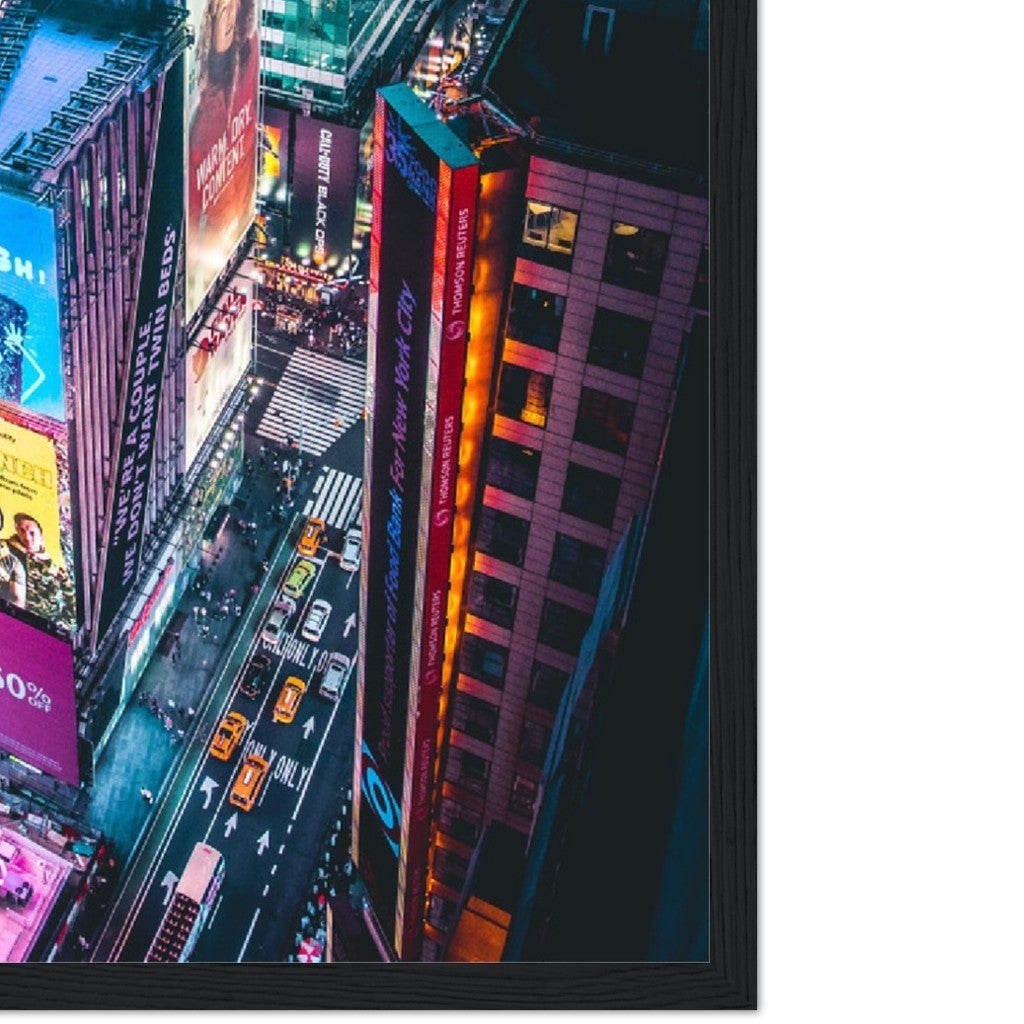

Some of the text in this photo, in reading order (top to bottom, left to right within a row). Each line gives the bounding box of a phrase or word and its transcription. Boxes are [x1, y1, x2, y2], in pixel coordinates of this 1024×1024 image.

[316, 185, 328, 226] BLACK
[452, 207, 469, 316] THOMSON REUTERS
[397, 278, 417, 335] City
[393, 336, 411, 392] York
[122, 543, 136, 585] WE
[138, 383, 156, 459] WANT
[148, 303, 167, 375] TWIN
[126, 428, 138, 445] A
[392, 392, 408, 452] New
[389, 449, 405, 493] For
[439, 415, 454, 504] THOMSON REUTERS
[387, 488, 403, 549] Bank
[384, 538, 400, 601] Food
[27, 696, 52, 713] OFF
[274, 754, 310, 792] ONLY
